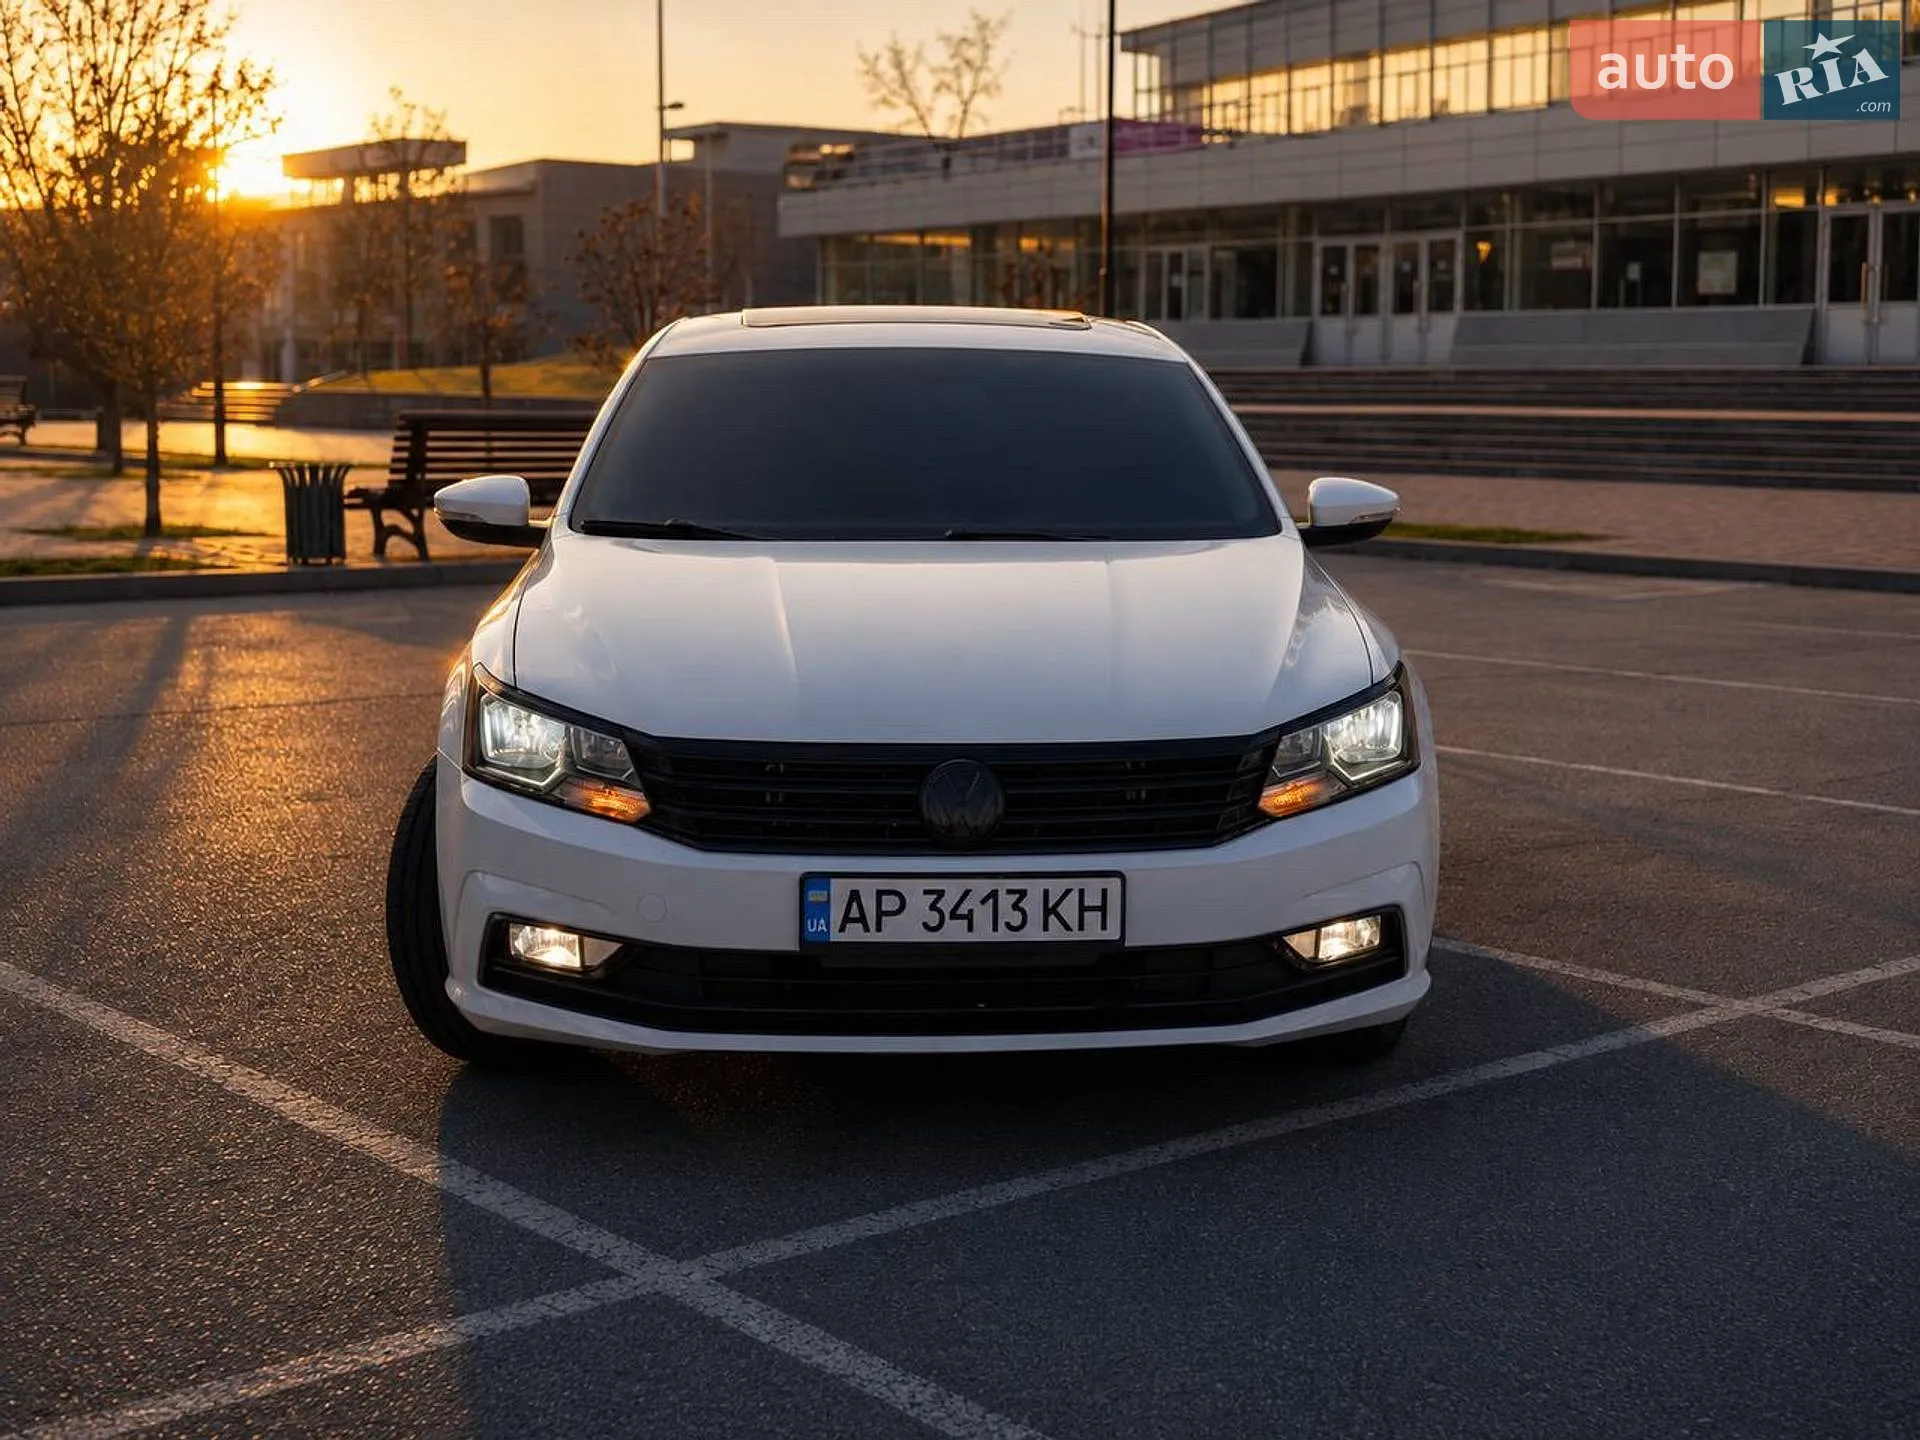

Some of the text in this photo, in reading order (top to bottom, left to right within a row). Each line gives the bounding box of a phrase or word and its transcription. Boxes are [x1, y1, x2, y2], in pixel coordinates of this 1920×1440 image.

[838, 887, 1108, 933] AP 3413 KH
[807, 918, 827, 933] UA
